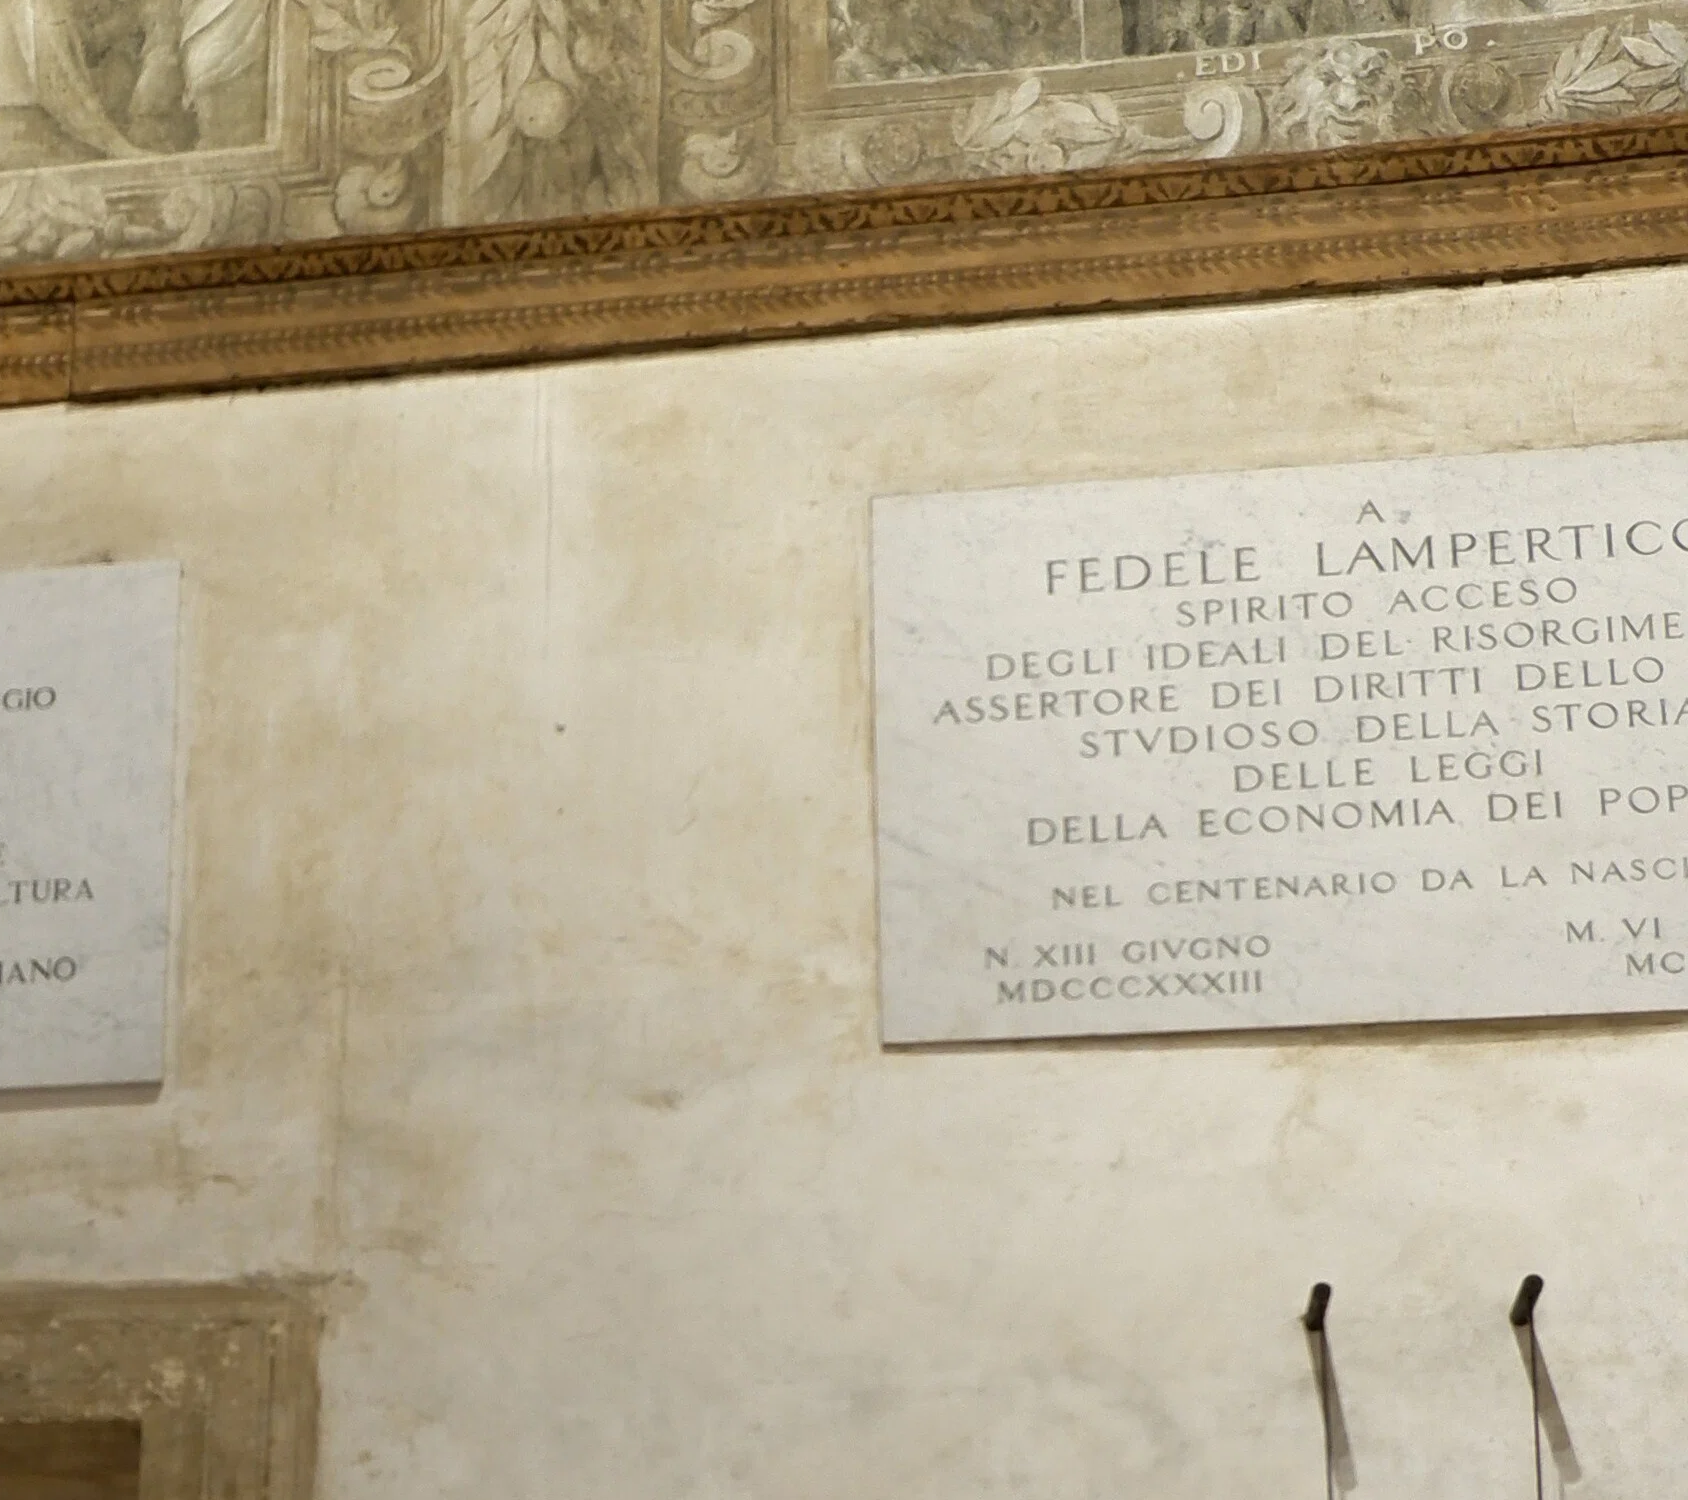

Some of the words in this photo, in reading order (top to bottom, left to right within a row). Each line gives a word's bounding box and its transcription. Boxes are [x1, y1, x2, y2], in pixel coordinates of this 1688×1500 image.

[1357, 501, 1384, 523] A
[1047, 548, 1259, 594] FEDELE
[1178, 592, 1352, 626] SPIRITO
[1389, 578, 1576, 613] ACCESO
[988, 648, 1113, 680] DEGLI
[1148, 637, 1284, 670] IDEALI
[1321, 631, 1402, 660] DEL
[1434, 613, 1683, 652] RISORGIME
[934, 686, 1178, 723] ASSERTORE
[1213, 680, 1280, 708] DEI
[1315, 668, 1480, 702] DIRITTI
[1517, 658, 1663, 690] DELLO
[1081, 720, 1317, 757] STVDIOSO
[1357, 711, 1498, 742] DELLA
[1235, 759, 1373, 792] DELLE
[1411, 748, 1541, 782] LEGGI
[1029, 814, 1166, 845] DELLA
[1199, 799, 1454, 836] ECONOMIA
[1489, 792, 1561, 821] DEI
[1053, 886, 1120, 909] NEL
[1149, 872, 1396, 904] CENTENARIO
[1423, 869, 1472, 890] DA
[1502, 867, 1547, 887] LA
[1623, 918, 1660, 938] VI
[1035, 944, 1094, 967] XIII
[1122, 936, 1270, 963] GIVGNO
[999, 970, 1261, 1003] MDCCCXXXIII
